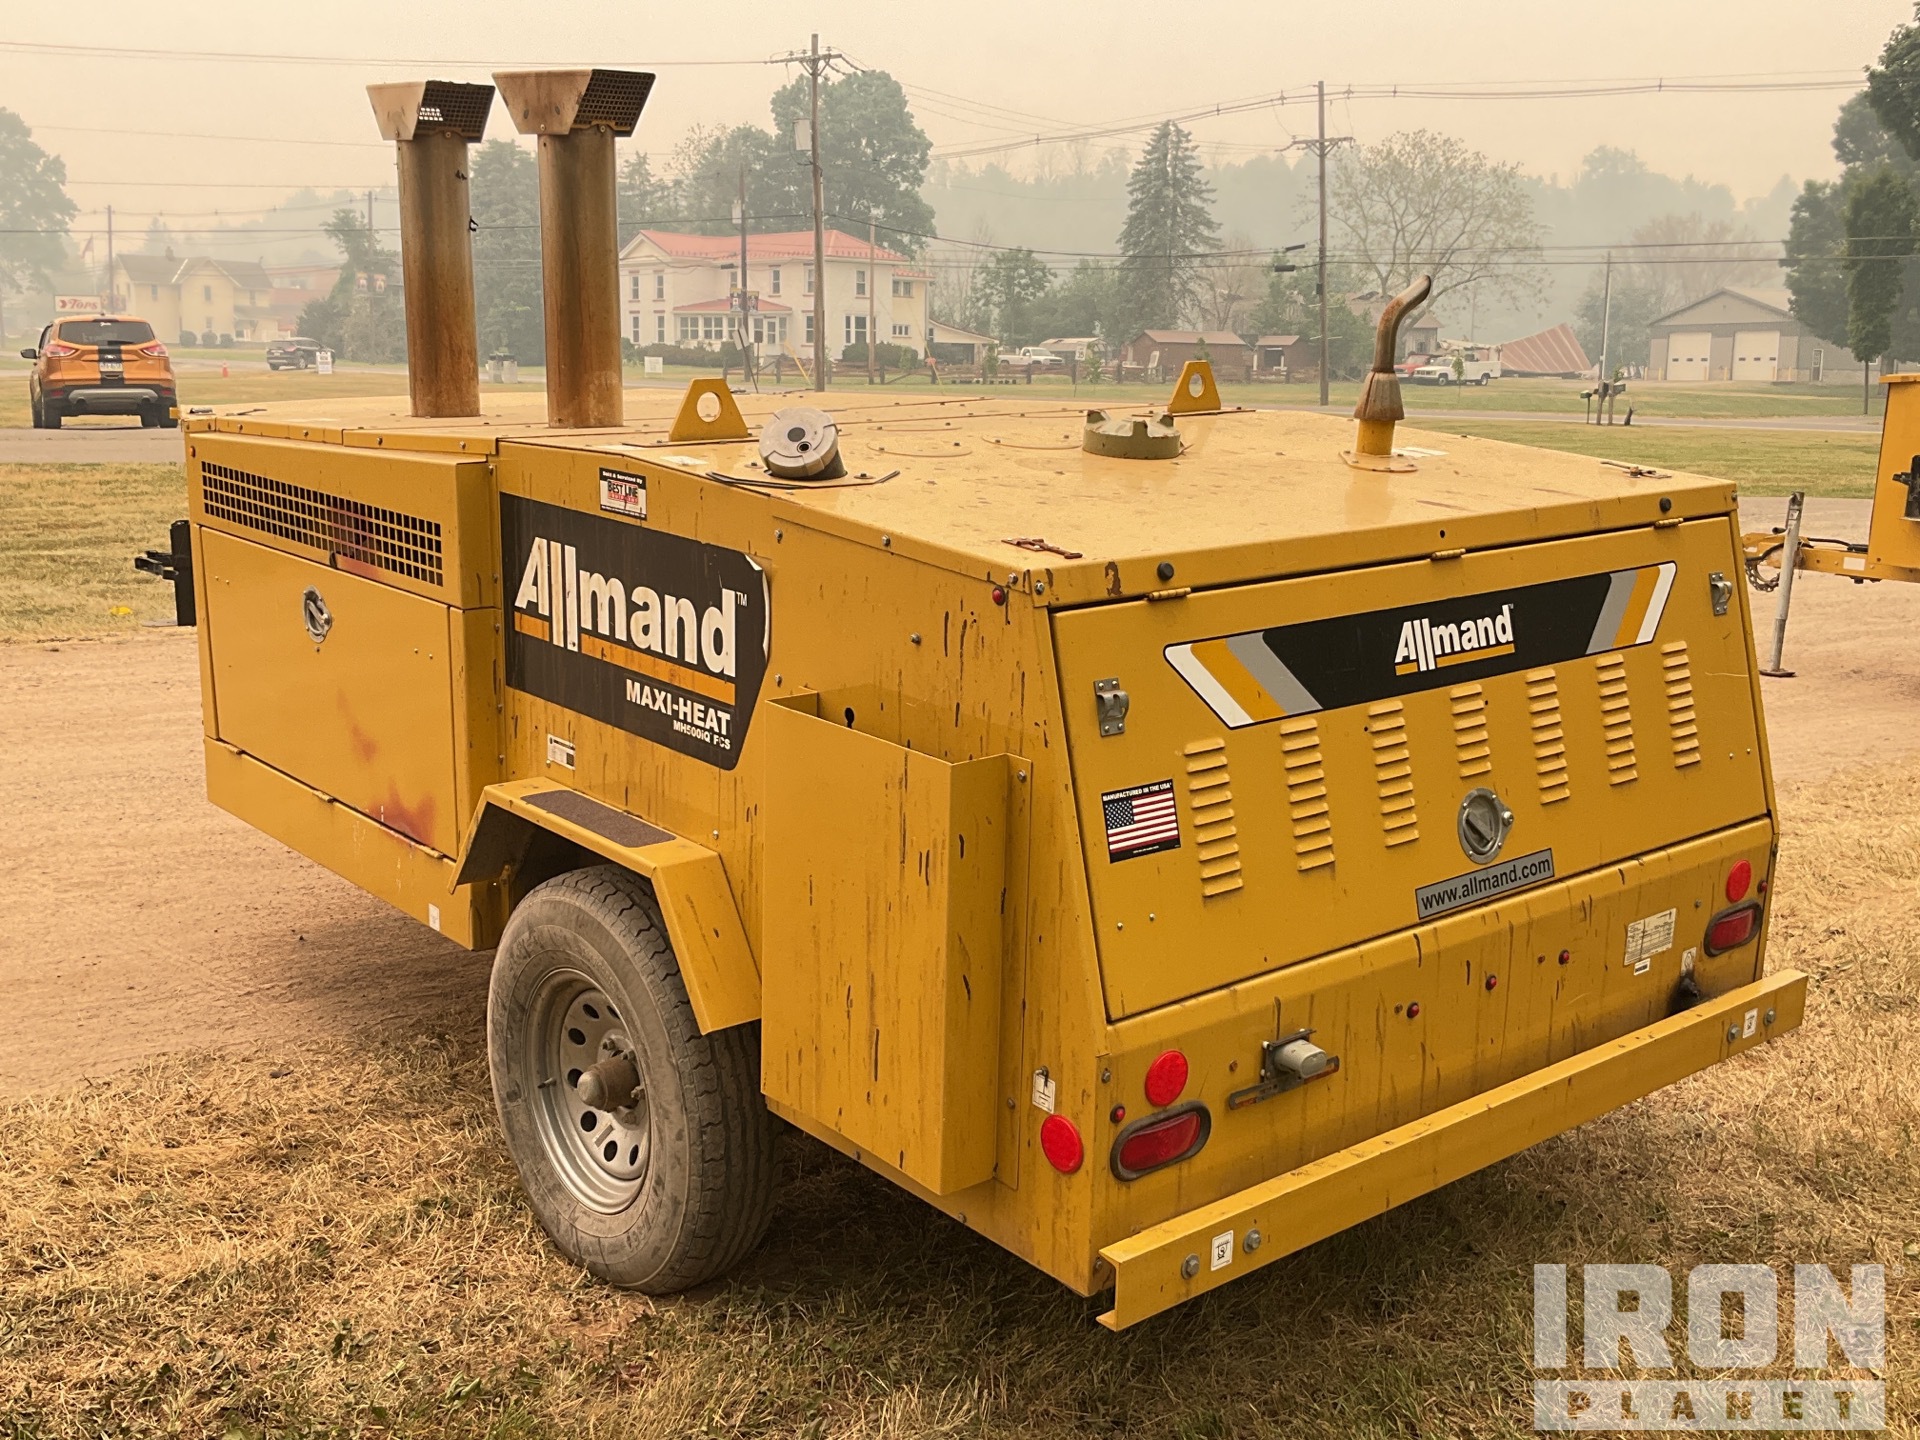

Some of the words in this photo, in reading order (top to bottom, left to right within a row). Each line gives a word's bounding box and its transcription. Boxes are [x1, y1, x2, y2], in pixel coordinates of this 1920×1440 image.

[607, 481, 623, 495] BEST
[514, 536, 736, 678] Allmand
[1394, 604, 1513, 672] Allmand
[626, 678, 731, 736] MAXI-HEAT
[713, 734, 731, 750] FCS
[1103, 789, 1142, 801] MANUFACTURED
[1149, 784, 1159, 792] THE
[1421, 858, 1551, 911] www.allmand.com
